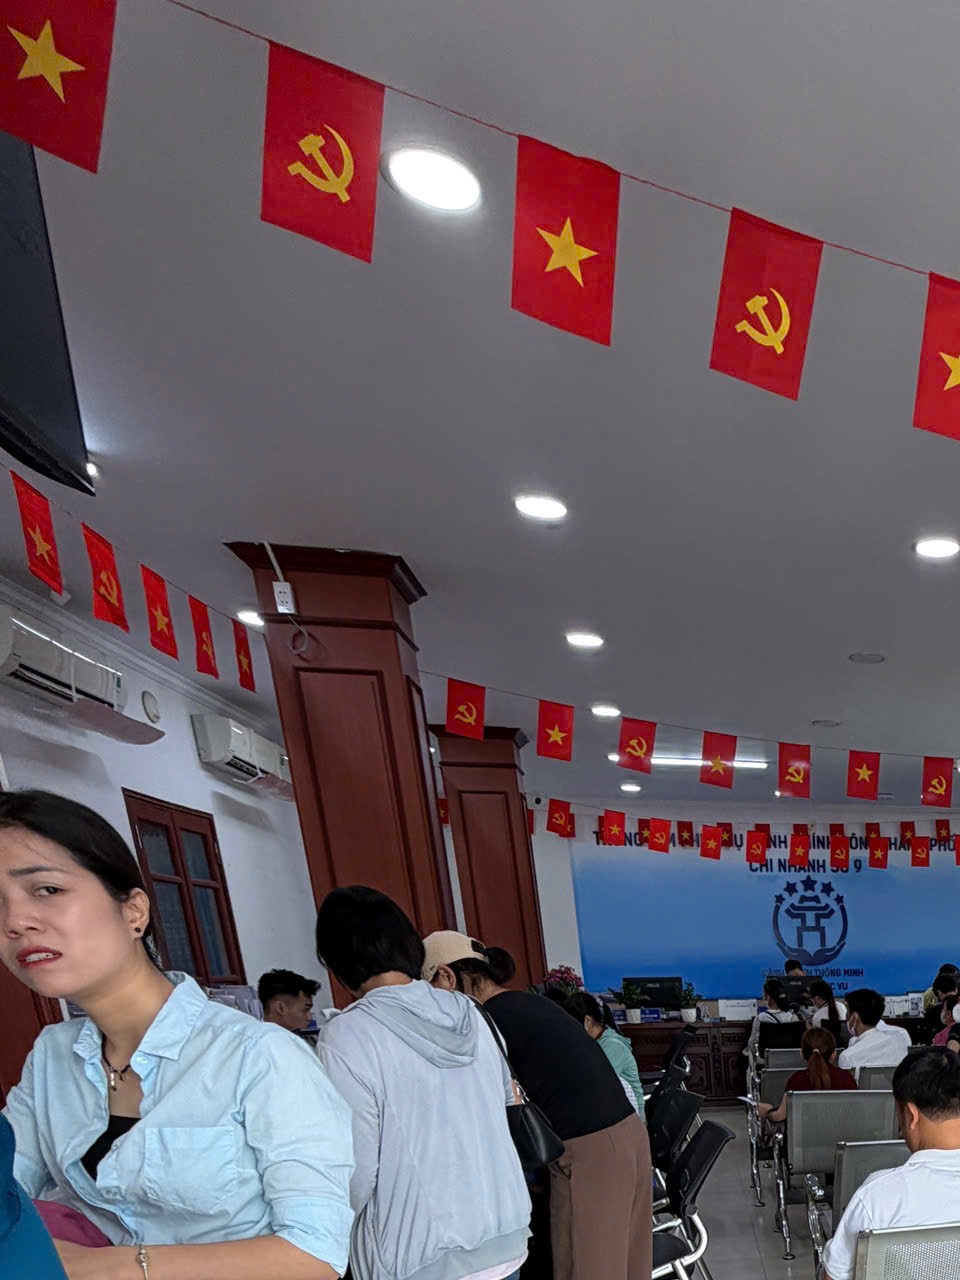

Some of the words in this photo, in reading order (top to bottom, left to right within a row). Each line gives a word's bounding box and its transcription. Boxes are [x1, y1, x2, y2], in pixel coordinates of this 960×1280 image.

[593, 831, 645, 848] TNG
[749, 858, 773, 873] CHI
[853, 859, 863, 873] 9
[843, 967, 864, 977] MINH
